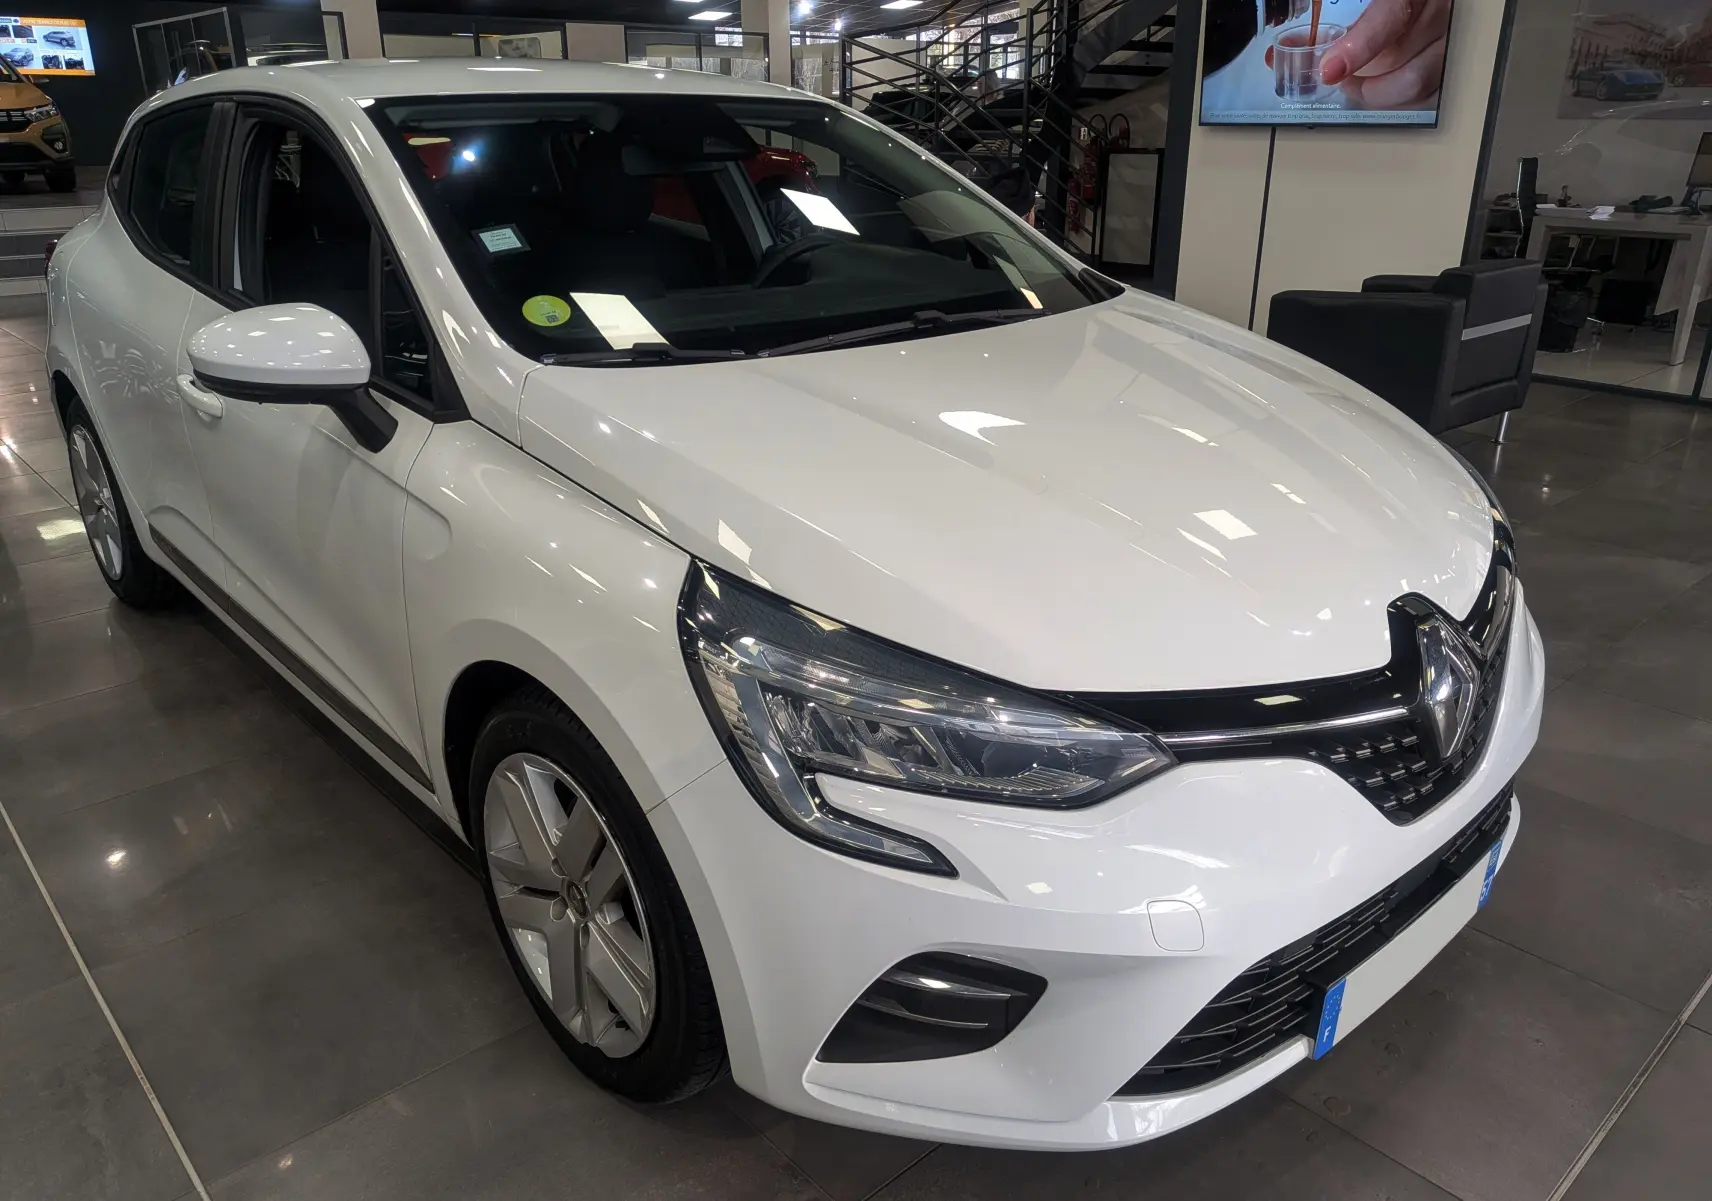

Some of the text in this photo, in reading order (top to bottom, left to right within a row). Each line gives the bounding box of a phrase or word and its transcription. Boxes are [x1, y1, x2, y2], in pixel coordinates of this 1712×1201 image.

[1280, 102, 1311, 110] Complément
[1480, 874, 1494, 901] 57
[1323, 1026, 1332, 1042] F
